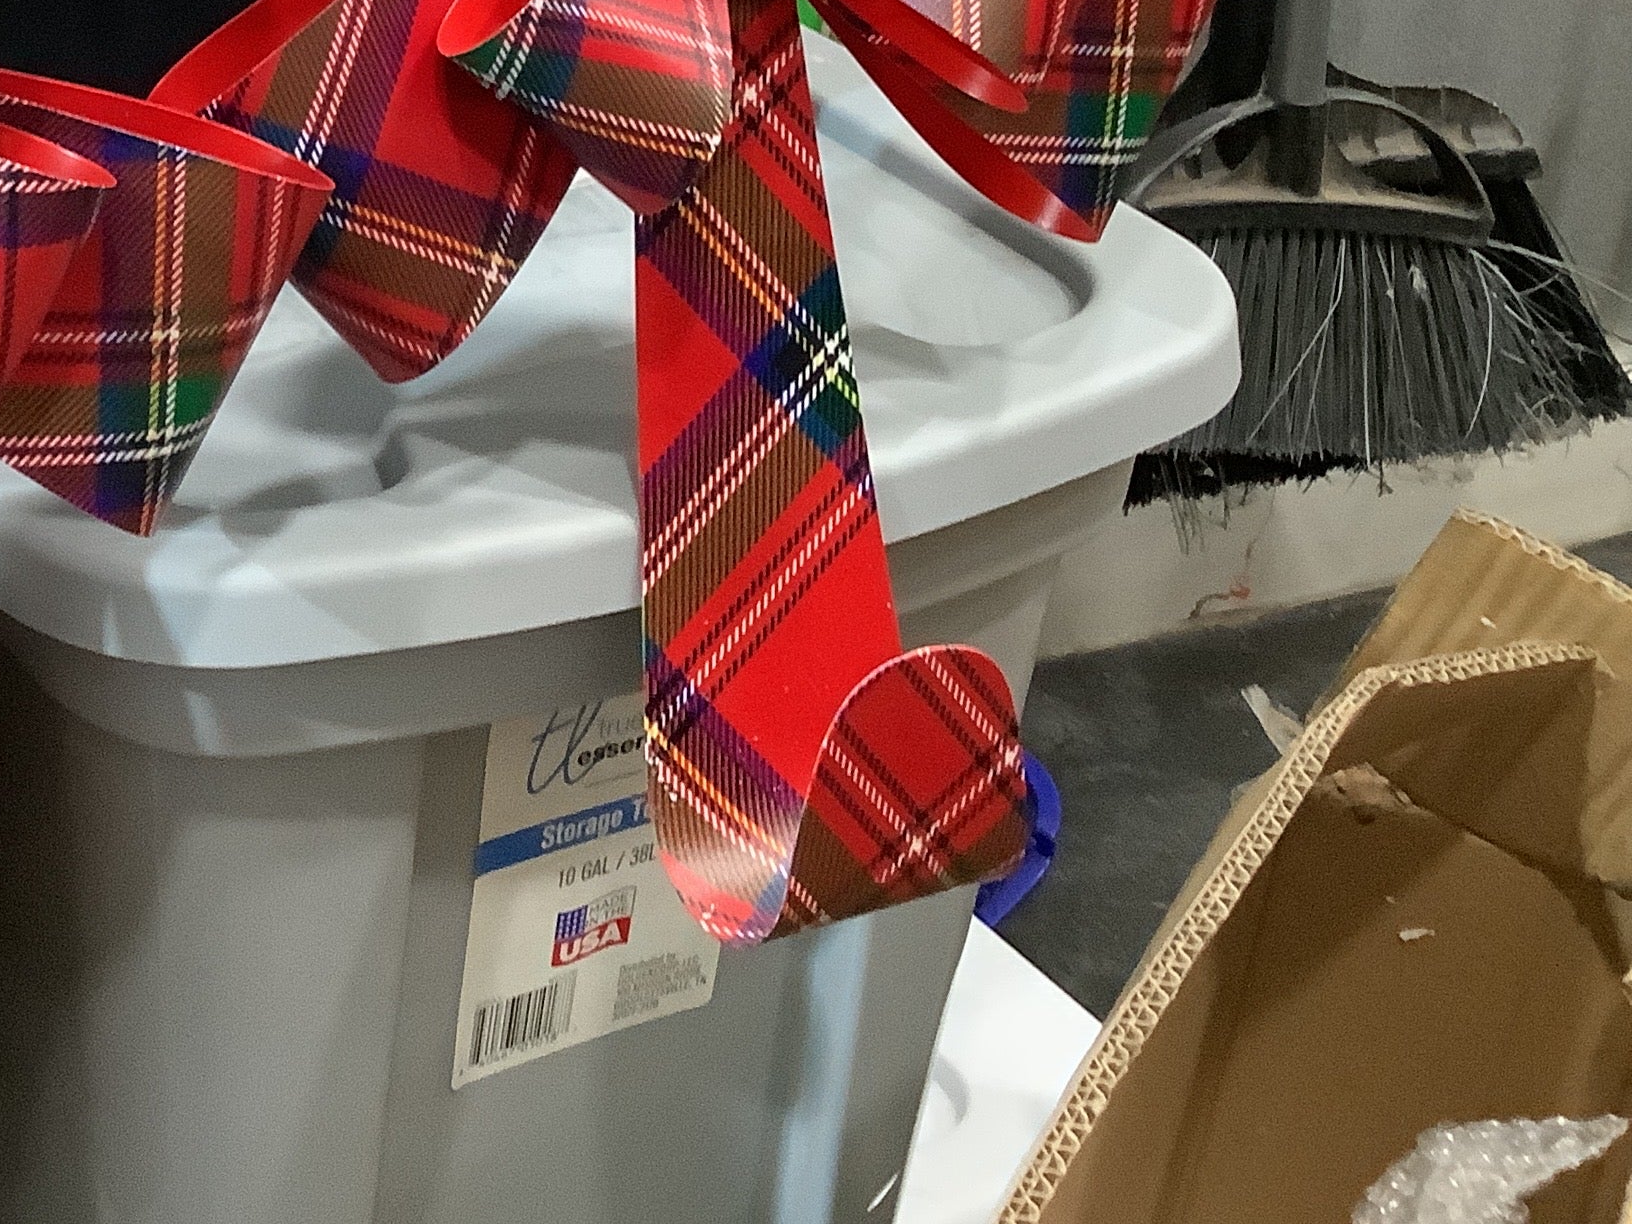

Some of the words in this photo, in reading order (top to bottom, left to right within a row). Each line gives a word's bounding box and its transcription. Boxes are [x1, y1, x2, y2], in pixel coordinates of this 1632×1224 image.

[541, 809, 623, 849] Storage
[559, 867, 576, 888] 10
[581, 855, 609, 881] GAL
[589, 892, 628, 914] MADE
[560, 922, 624, 963] USA
